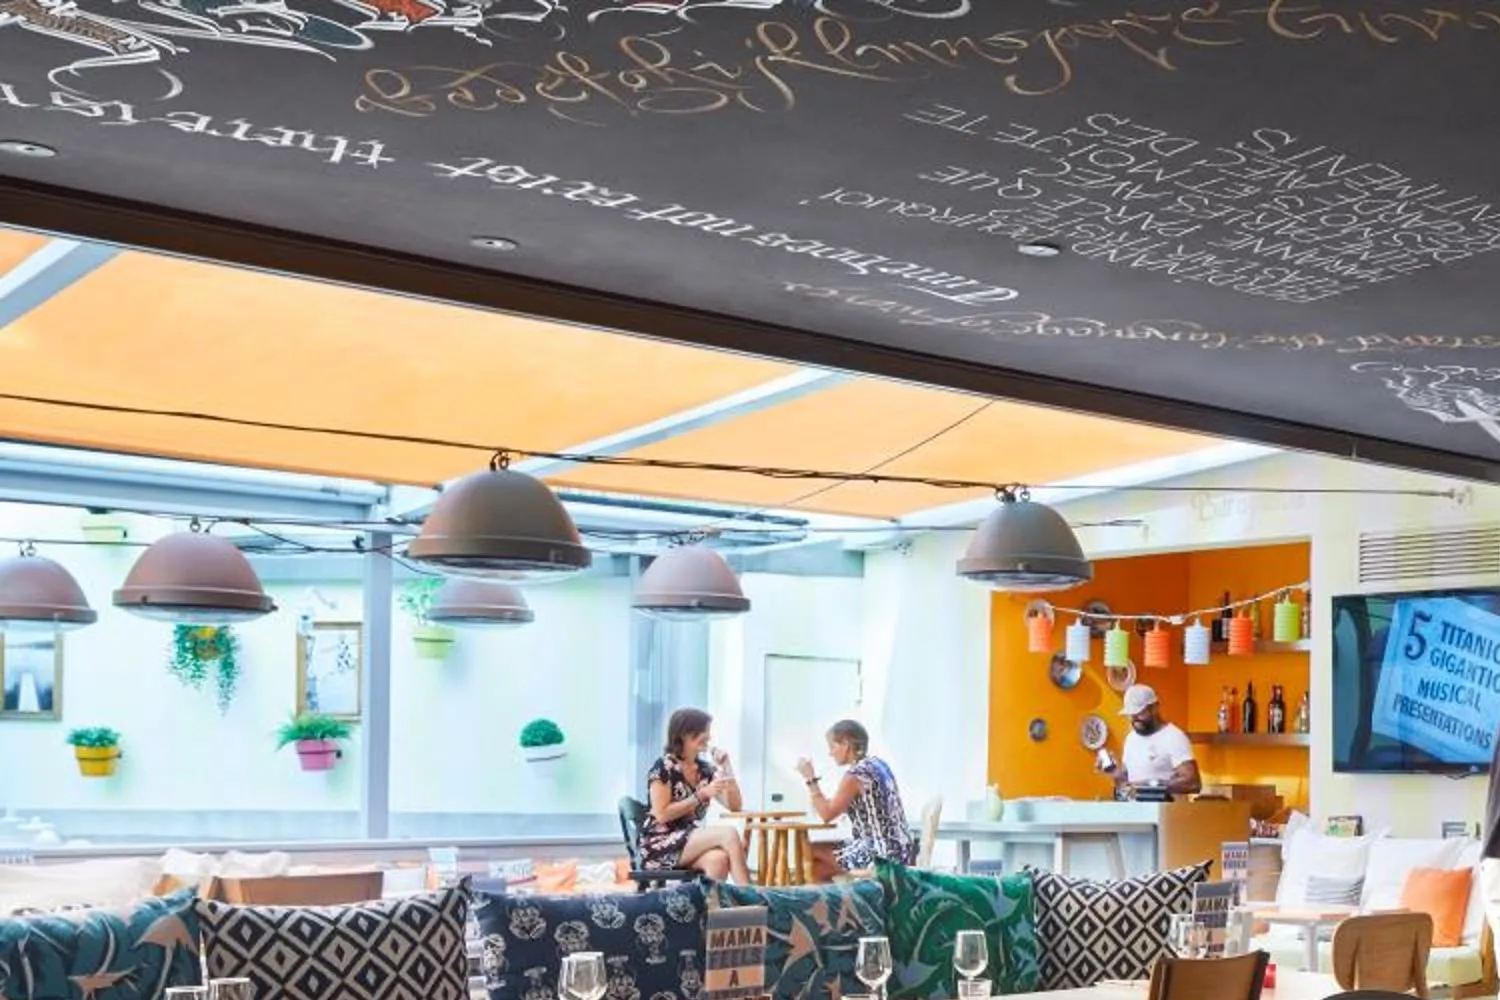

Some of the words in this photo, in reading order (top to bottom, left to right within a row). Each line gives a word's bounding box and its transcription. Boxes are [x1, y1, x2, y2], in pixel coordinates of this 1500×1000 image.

[900, 99, 997, 134] TE
[1060, 110, 1204, 158] DES
[152, 112, 395, 168] there
[985, 122, 1080, 155] JE
[914, 161, 1051, 203] QUE
[1018, 155, 1172, 204] AVEC
[1063, 142, 1192, 183] MOI
[1184, 146, 1339, 198] AVEC
[1168, 171, 1266, 201] ET
[624, 204, 755, 237] not
[1026, 189, 1205, 237] PARCE
[1154, 193, 1345, 244] PARLES
[1250, 193, 1399, 240] MOTS
[1370, 230, 1475, 263] DES
[1404, 610, 1433, 660] 5
[1417, 678, 1481, 712] MUSICAL
[1393, 692, 1494, 749] PRESENTATIONS
[710, 927, 763, 949] MAMA
[730, 969, 739, 987] A
